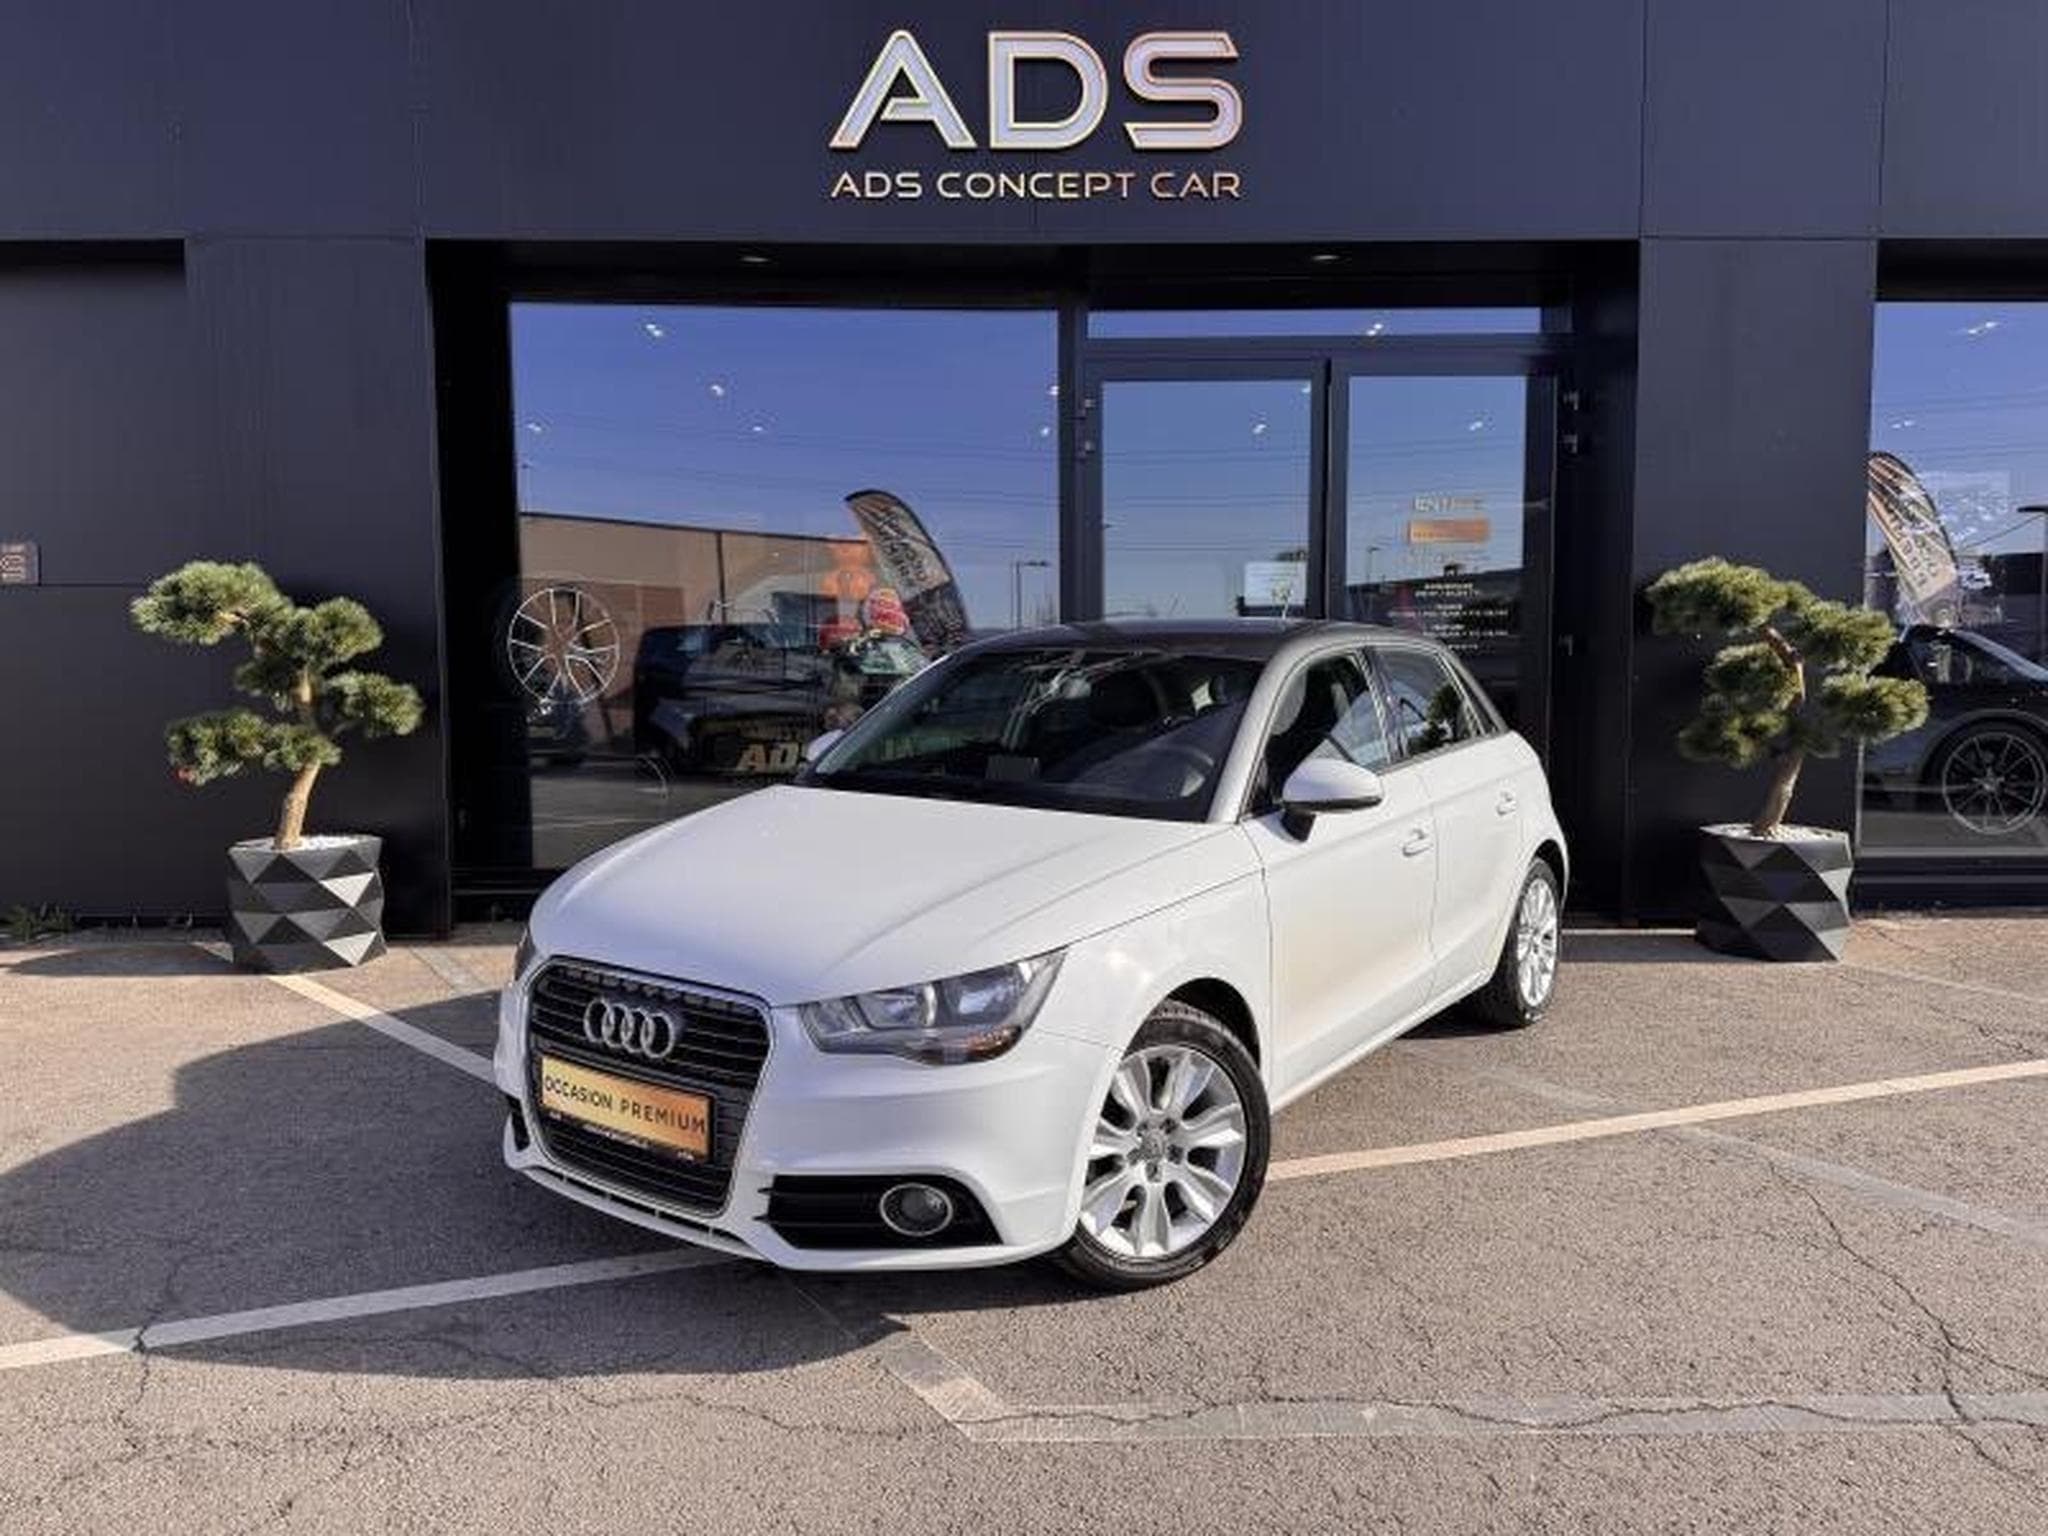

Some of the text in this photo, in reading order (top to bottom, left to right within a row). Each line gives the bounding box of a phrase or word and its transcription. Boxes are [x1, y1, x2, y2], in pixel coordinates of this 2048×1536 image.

[829, 29, 1243, 149] ADS
[831, 172, 1240, 198] ADS CONCEPT CAR
[544, 1075, 705, 1133] OCCASION PREMIUM
